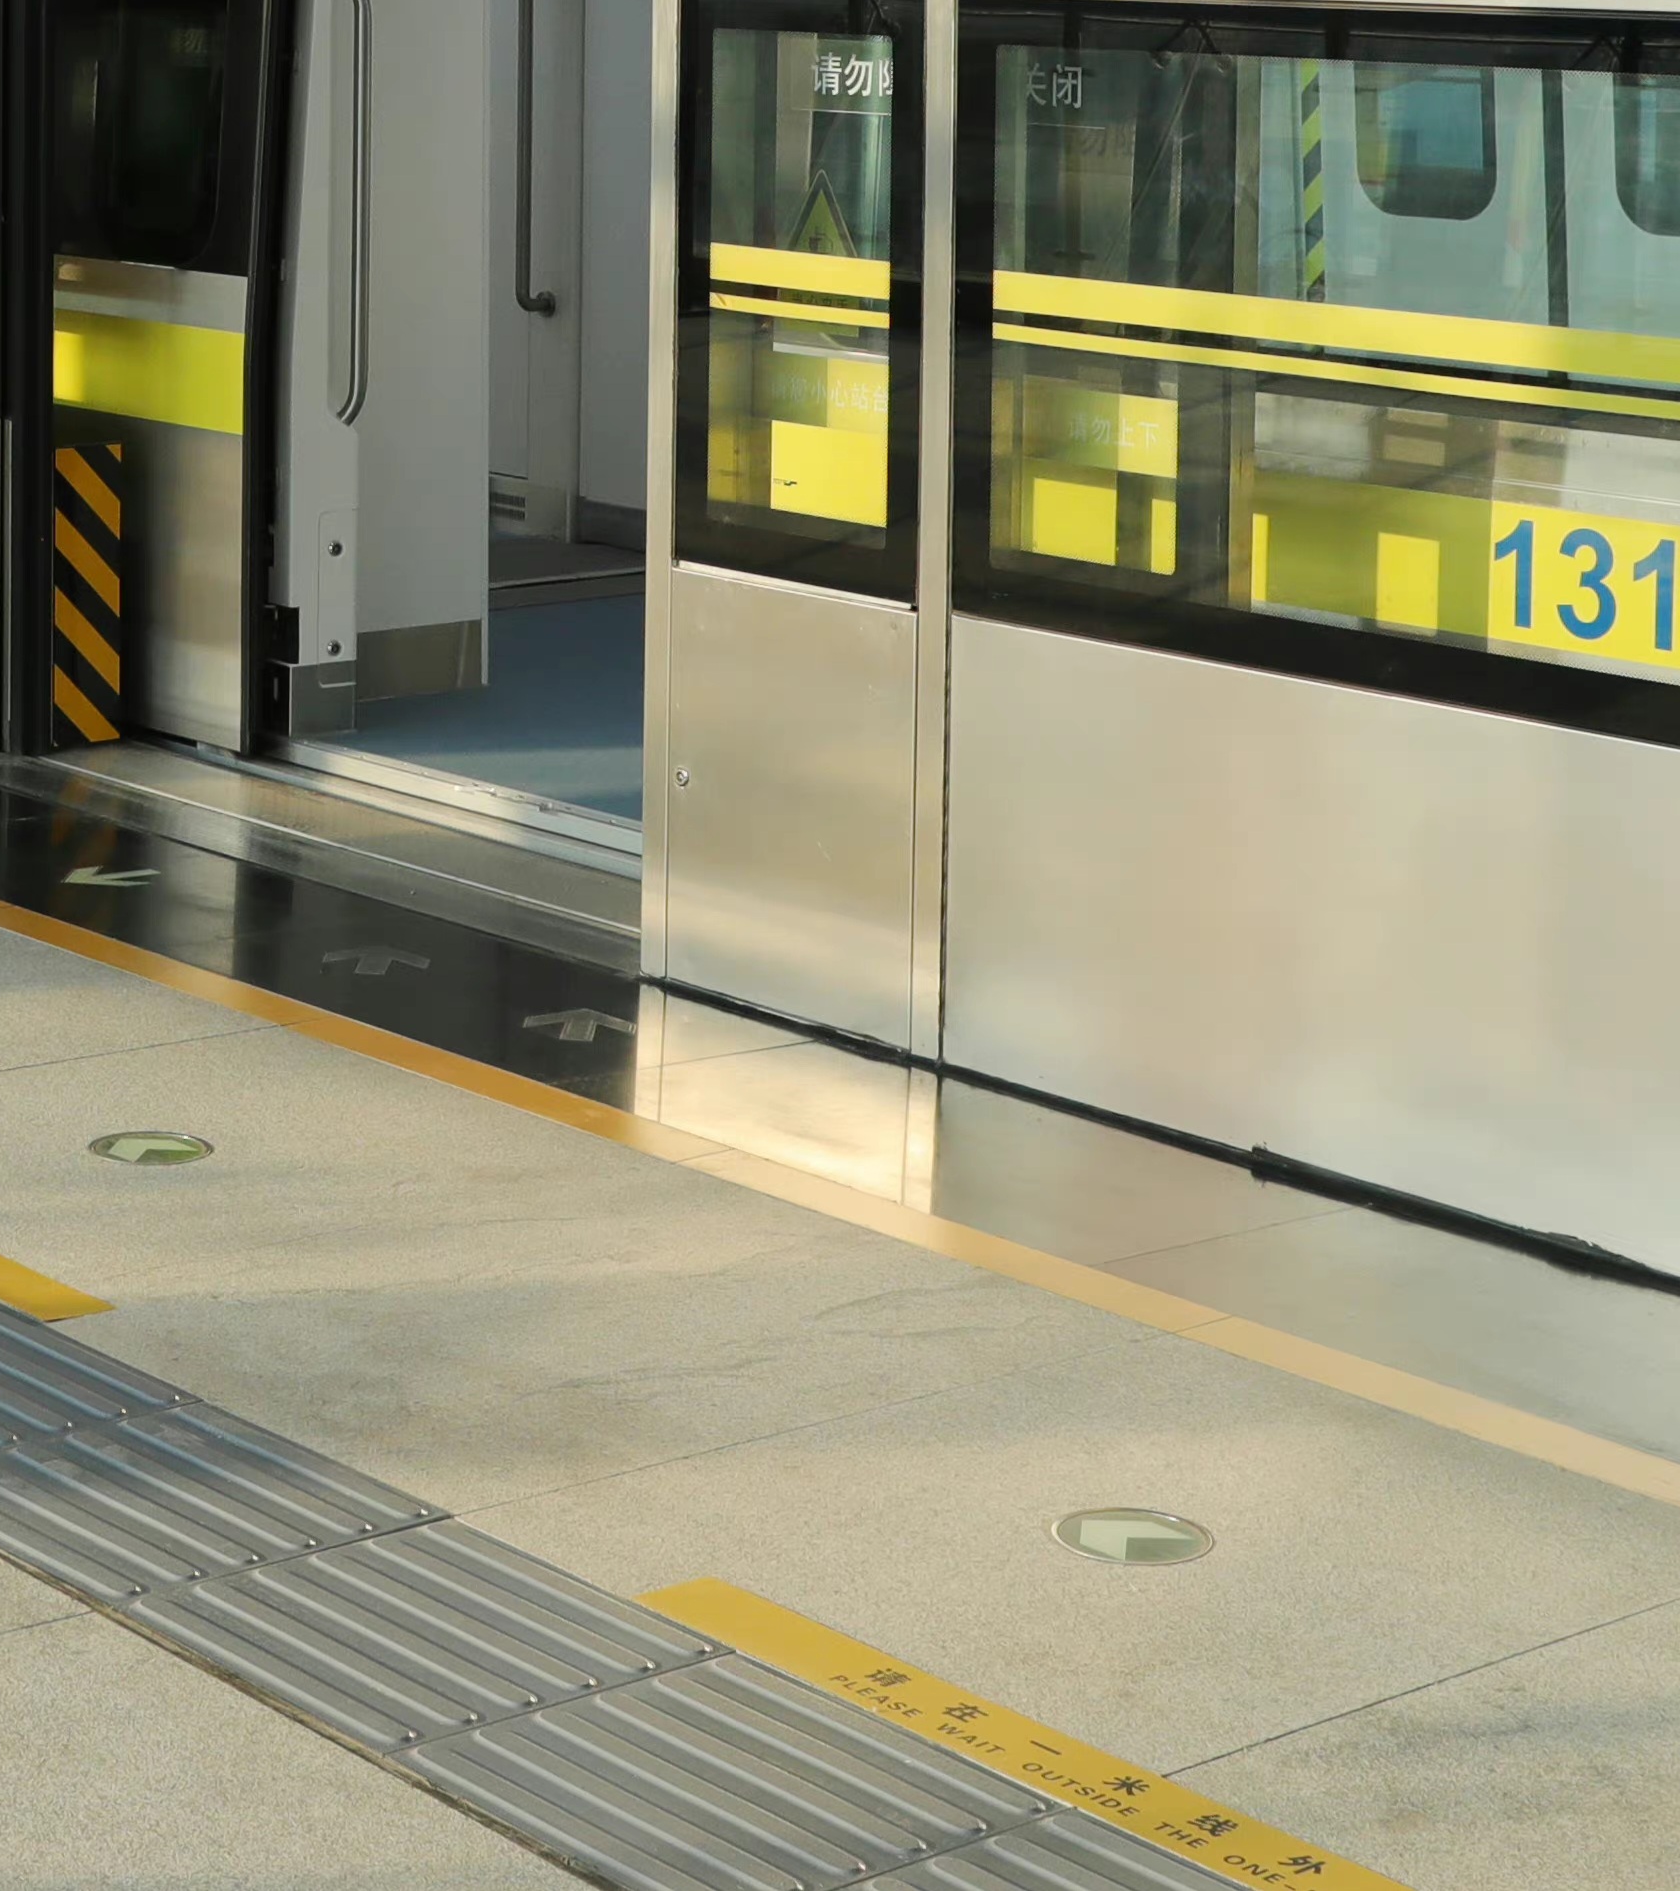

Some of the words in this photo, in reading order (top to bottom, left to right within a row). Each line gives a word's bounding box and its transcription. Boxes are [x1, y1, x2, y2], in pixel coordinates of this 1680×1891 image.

[828, 1673, 924, 1719] PLEASE
[936, 1722, 1007, 1755] WAIT
[1020, 1761, 1141, 1817] OUTSIDE
[1152, 1821, 1210, 1850] THE
[1222, 1854, 1318, 1891] ONE-
